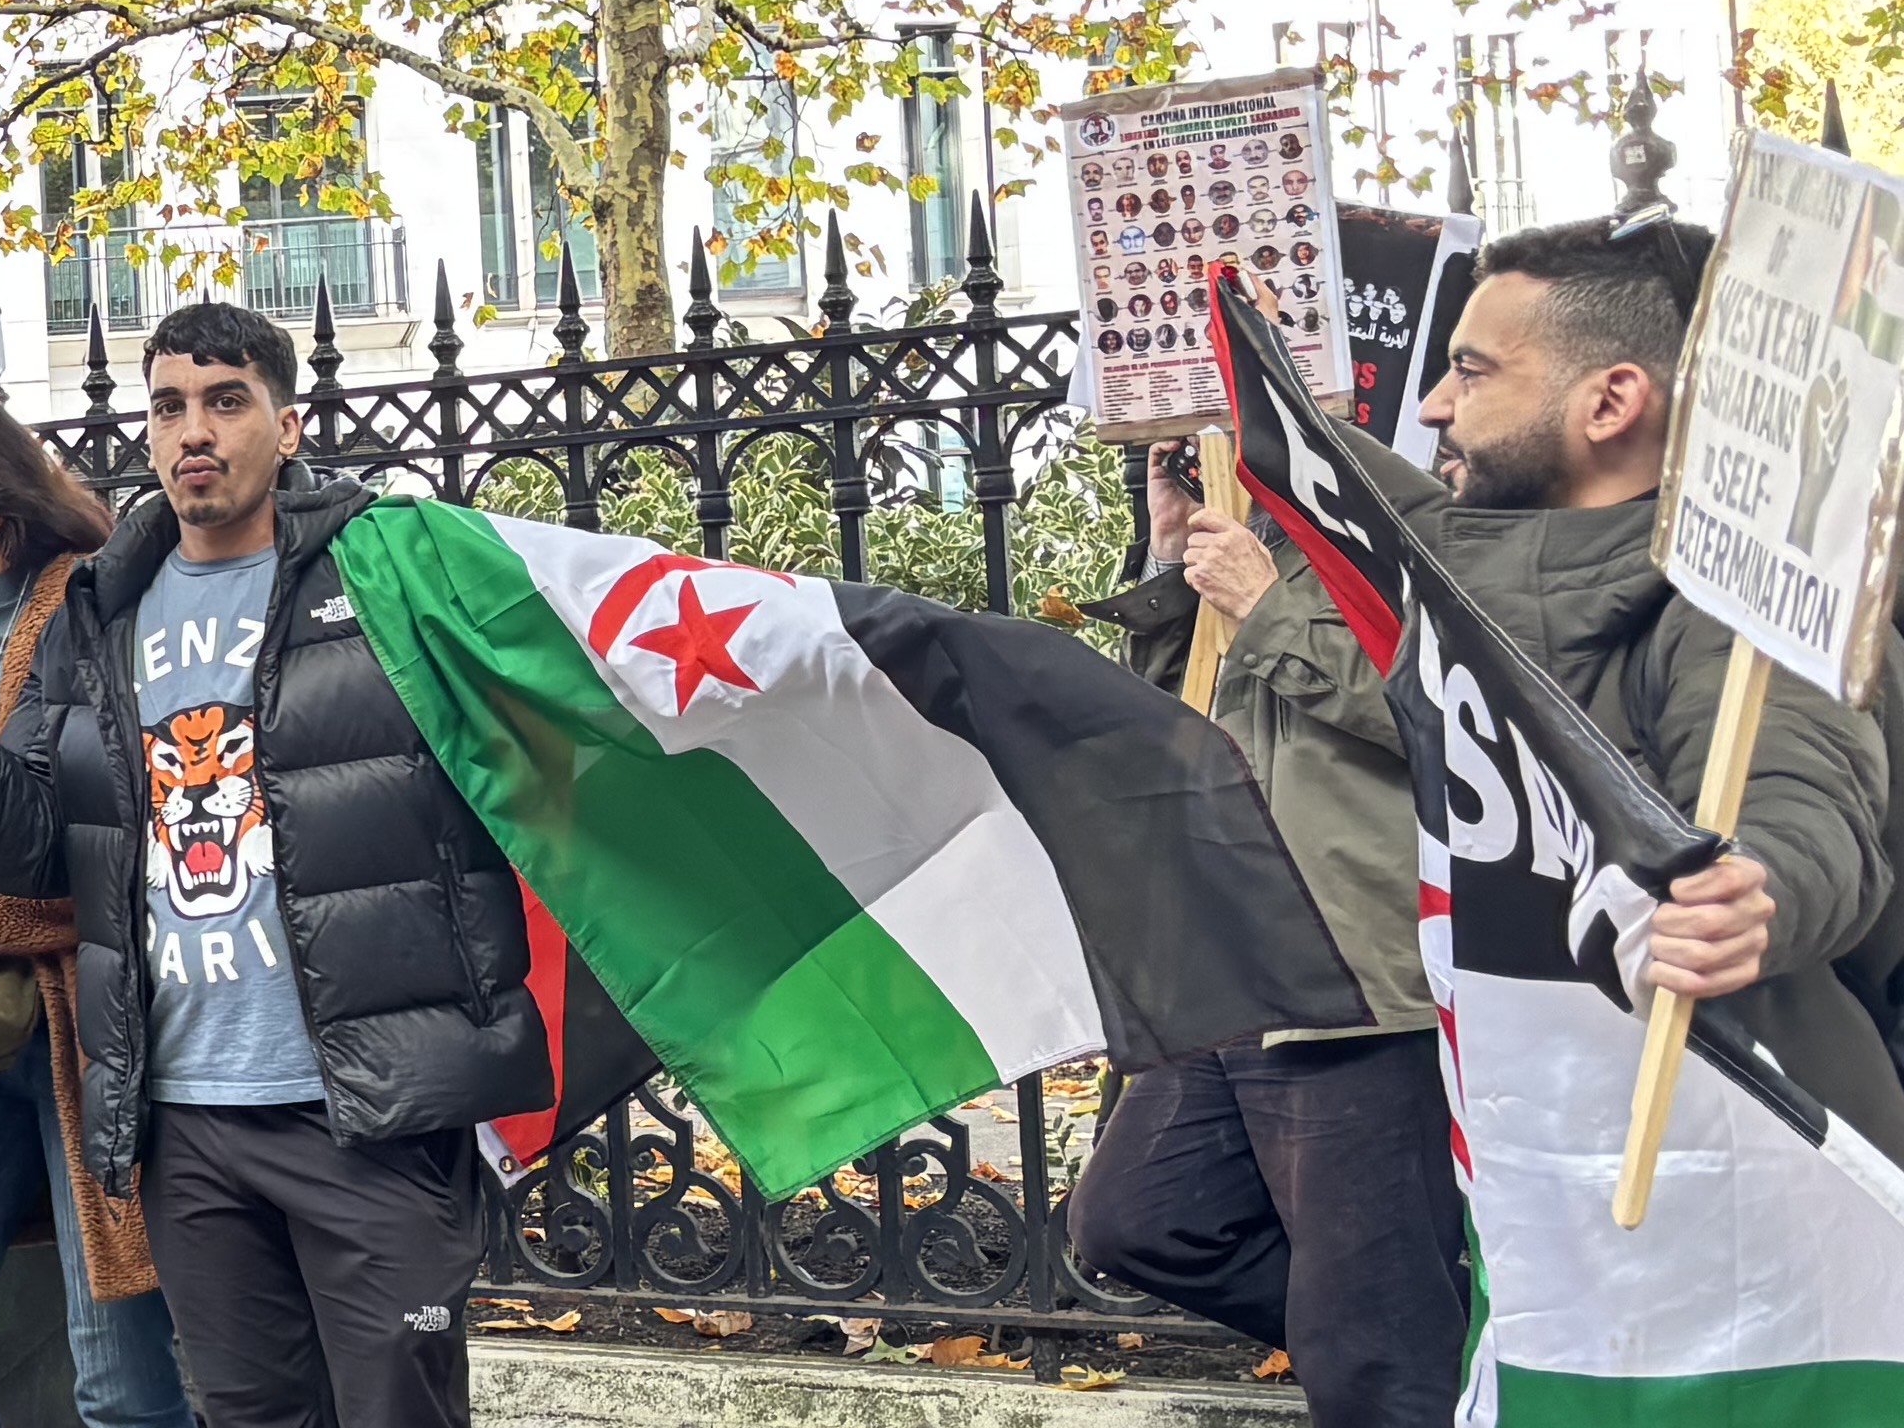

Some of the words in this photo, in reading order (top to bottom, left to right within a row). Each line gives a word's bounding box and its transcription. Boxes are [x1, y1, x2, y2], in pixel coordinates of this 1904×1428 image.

[1717, 274, 1821, 381] WESTERN
[1699, 351, 1802, 454] SAHARANS
[1713, 445, 1771, 520] SELF-
[1675, 495, 1840, 654] DETERMINATION
[134, 617, 265, 694] ENZ
[146, 918, 277, 985] ARI
